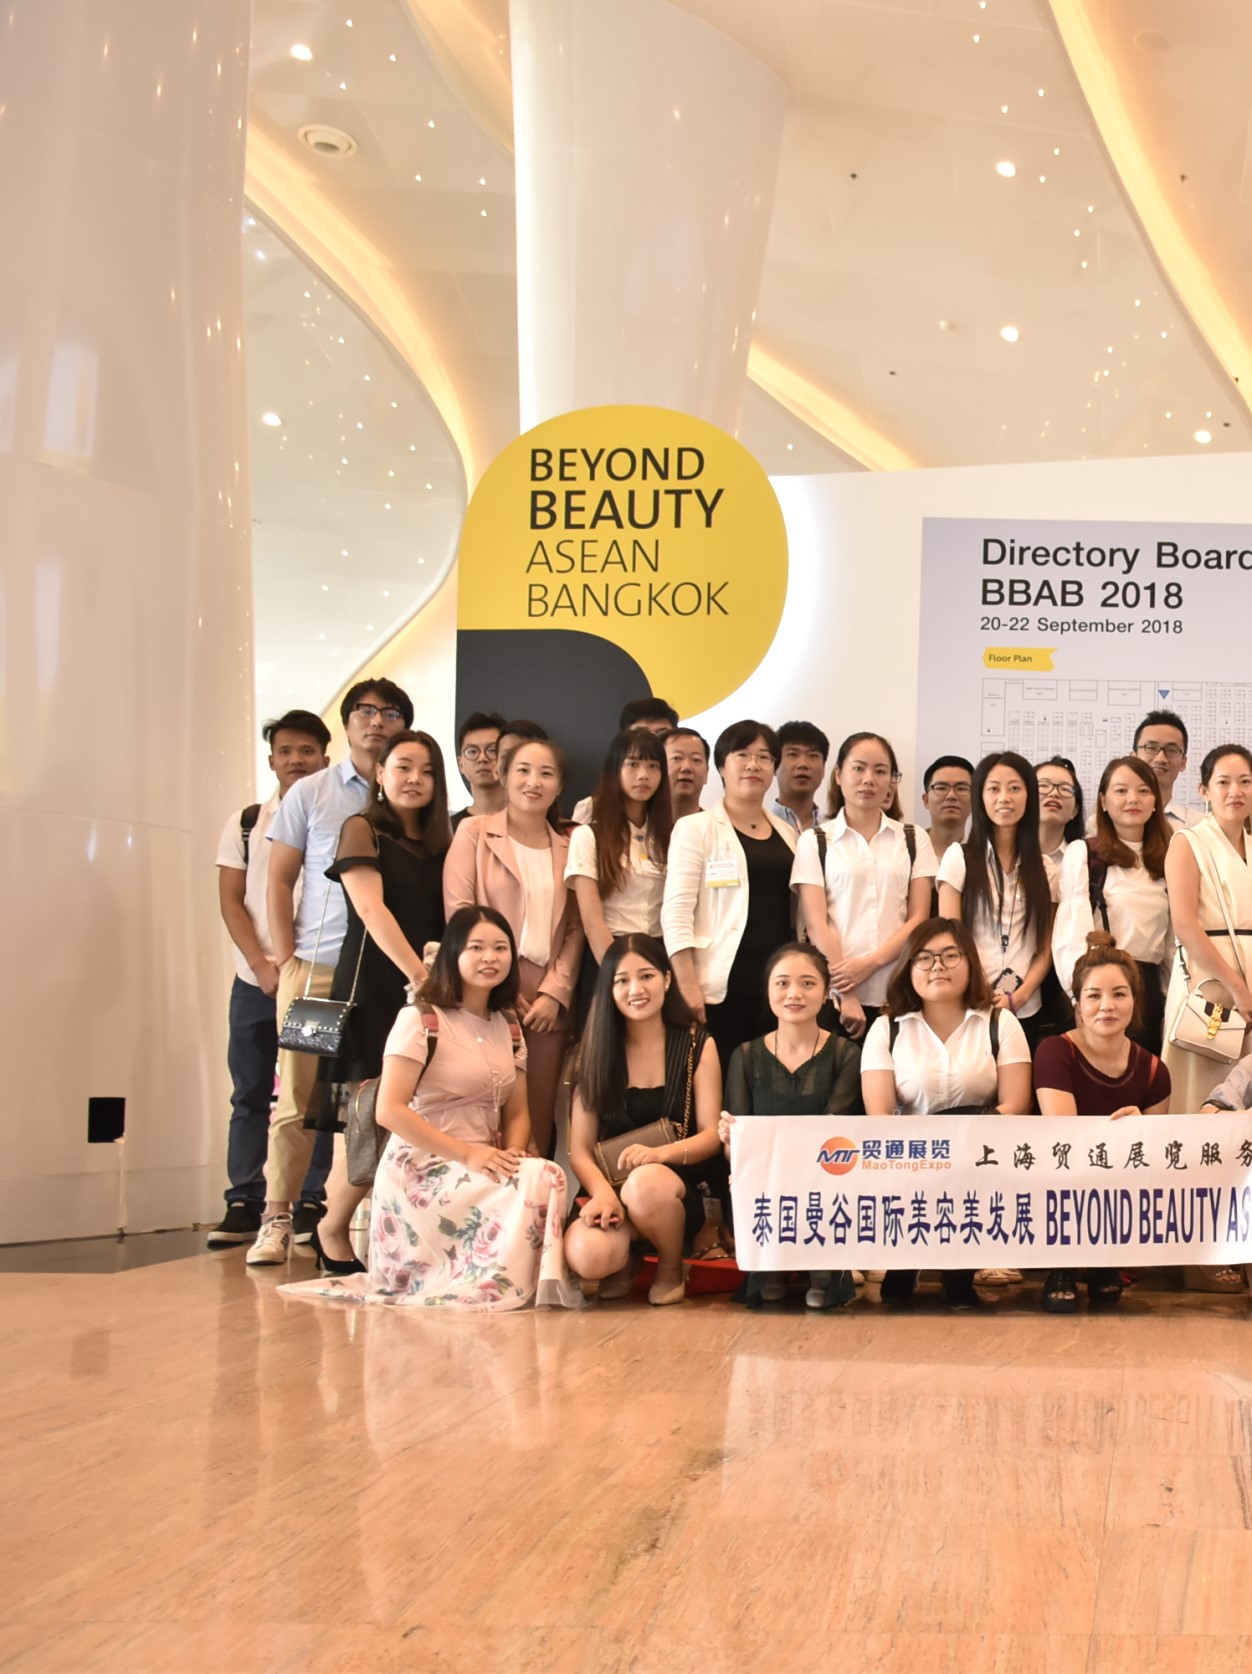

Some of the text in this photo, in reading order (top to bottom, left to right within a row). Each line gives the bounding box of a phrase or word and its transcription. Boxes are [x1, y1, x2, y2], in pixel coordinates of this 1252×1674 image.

[530, 447, 705, 482] BEYOND
[530, 488, 725, 530] BEAUTY
[525, 538, 660, 574] ASEAN
[982, 538, 1140, 575] Directory
[527, 581, 729, 618] BANGKOK
[981, 578, 1183, 609] BBAB 2018
[980, 616, 1183, 635] 20-22 September 2018
[988, 654, 1033, 663] Floor Plan
[861, 1160, 952, 1172] MaoTongExpo
[862, 1139, 951, 1160] 贸通展览
[752, 1190, 1035, 1247] 泰国曼谷国际美容美发展
[1046, 1188, 1133, 1246] BEYOND
[1139, 1187, 1222, 1244] BEAUTY
